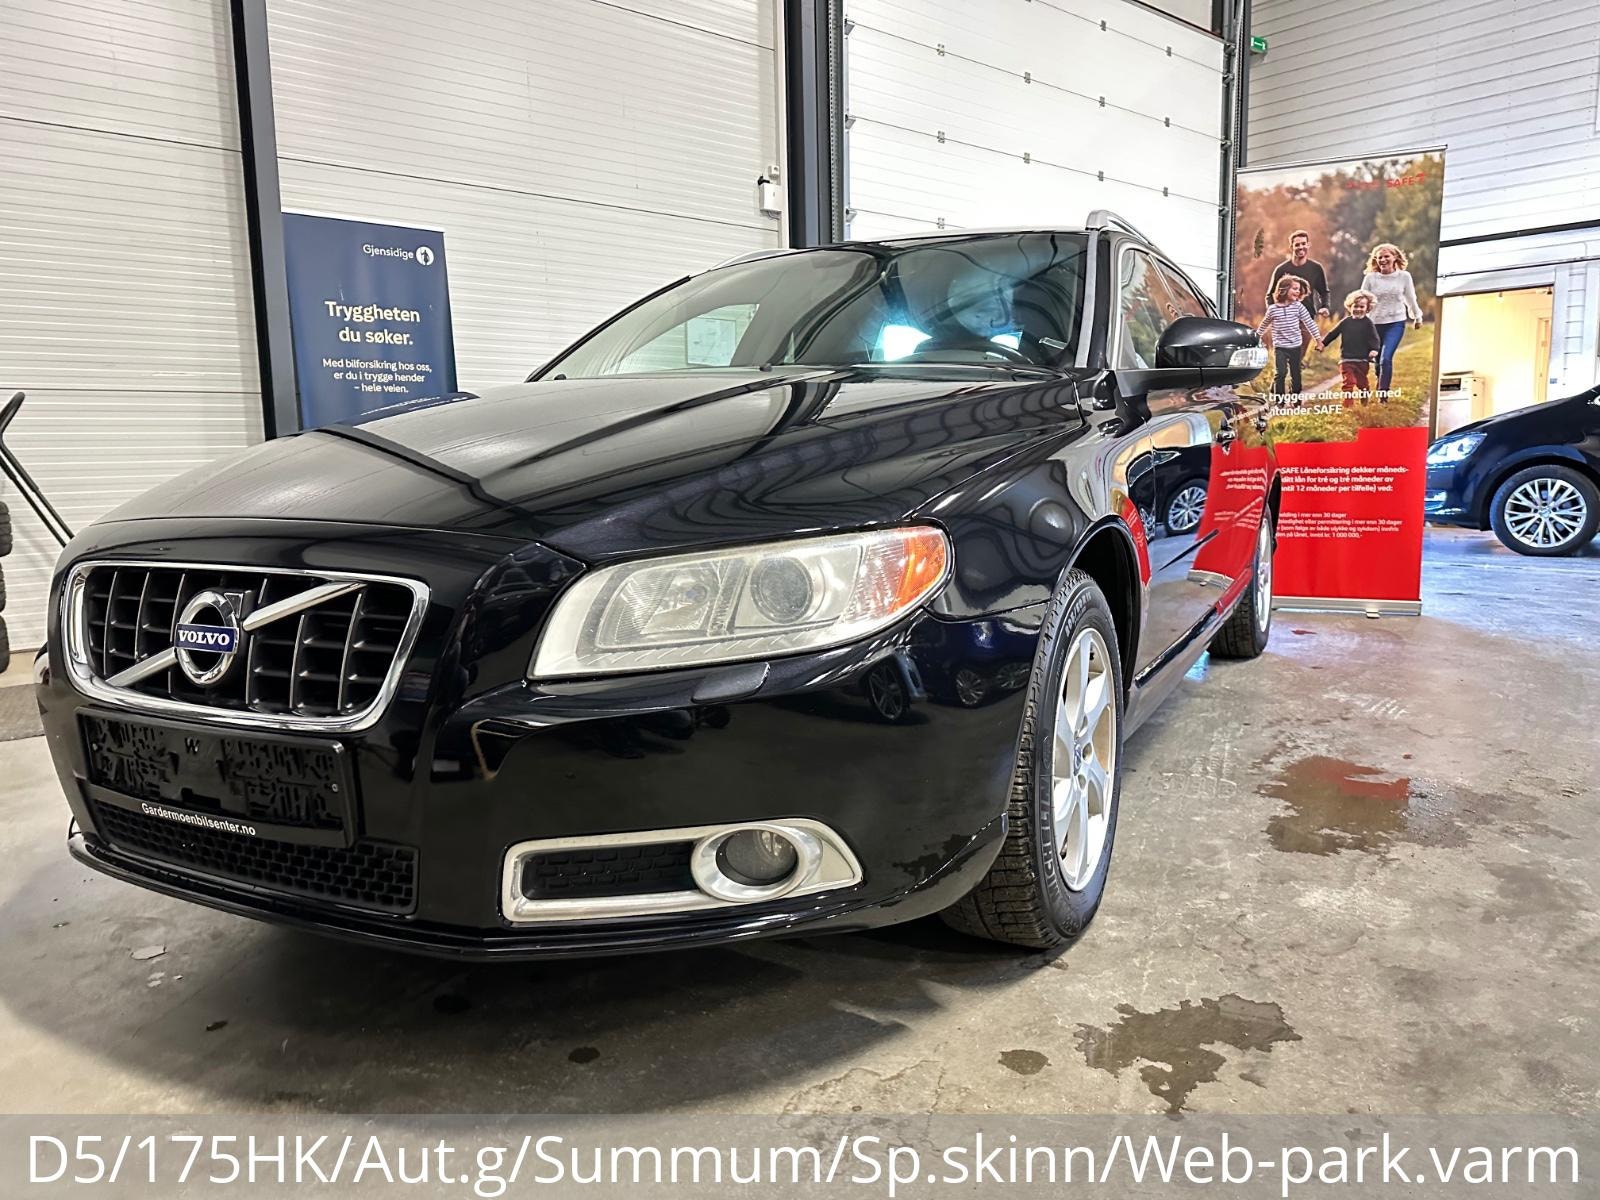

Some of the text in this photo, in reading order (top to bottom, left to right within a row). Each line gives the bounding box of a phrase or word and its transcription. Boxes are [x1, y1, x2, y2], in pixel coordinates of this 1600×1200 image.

[1386, 177, 1414, 188] SAFE
[363, 244, 414, 260] Gjensidige
[324, 300, 420, 322] Tryggheten
[339, 327, 414, 345] du søker.
[322, 358, 432, 373] Med bilforsikring hos oss,
[333, 372, 343, 380] er
[345, 371, 358, 380] du
[364, 372, 393, 383] trygge
[394, 373, 425, 382] hender
[361, 383, 382, 392] hele
[383, 384, 409, 393] veien.
[1269, 391, 1315, 404] tryggere
[1317, 388, 1373, 401] alternativ
[1375, 388, 1402, 398] med
[1313, 404, 1343, 415] SAFE
[1351, 466, 1376, 474] dekker
[1295, 475, 1306, 483] lån
[1307, 475, 1317, 483] for
[1351, 474, 1383, 483] måneder
[178, 630, 230, 646] VOLVO
[141, 802, 256, 836] Gardermoenbilsenter.no
